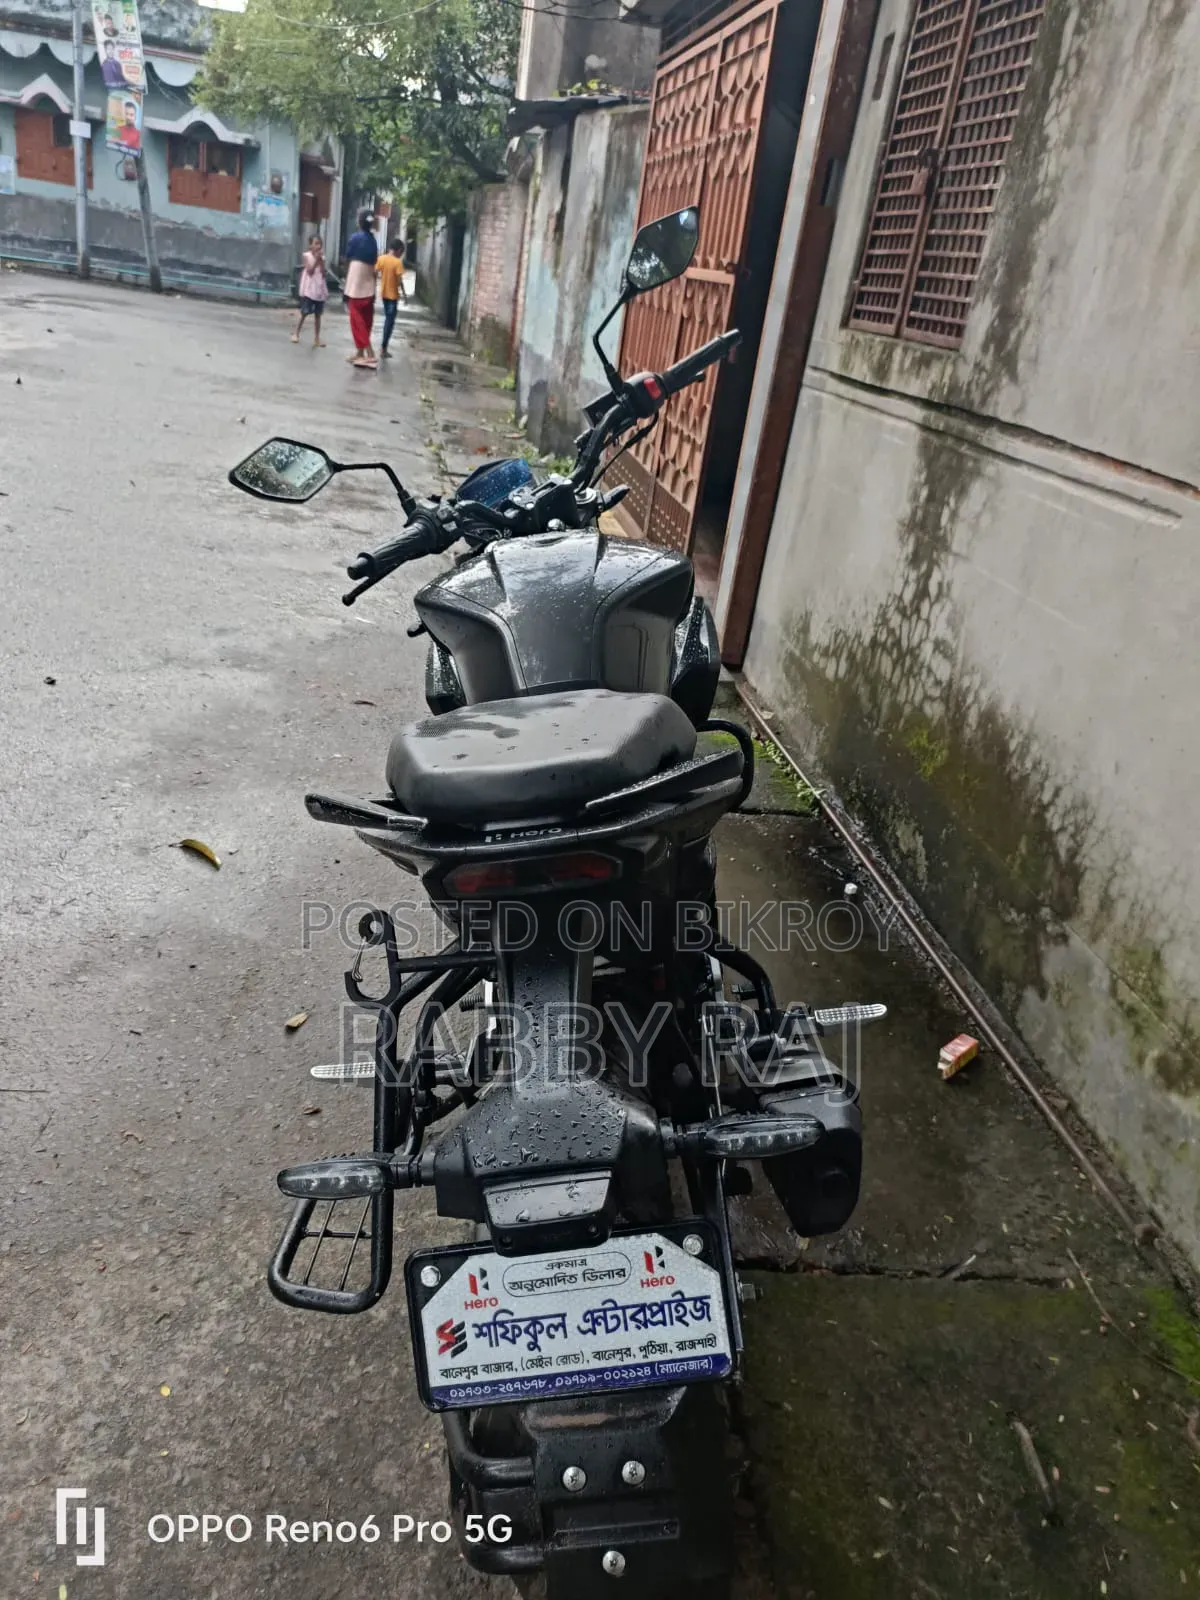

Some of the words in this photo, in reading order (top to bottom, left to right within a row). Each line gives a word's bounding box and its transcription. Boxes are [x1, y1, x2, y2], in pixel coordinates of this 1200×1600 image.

[545, 1258, 587, 1271] একমাত্র
[508, 1273, 578, 1292] অনুমোদিত
[582, 1267, 626, 1284] ডিলার
[639, 1274, 675, 1288] Hero
[464, 1296, 499, 1310] Hero
[471, 1308, 568, 1352] শফিকুল
[576, 1290, 712, 1336] এন্টারপ্রাইজ
[481, 1360, 518, 1376] বাজার,
[520, 1356, 553, 1373] (মেইন
[555, 1350, 590, 1369] রোড),
[675, 1333, 717, 1352] রাজশাহী
